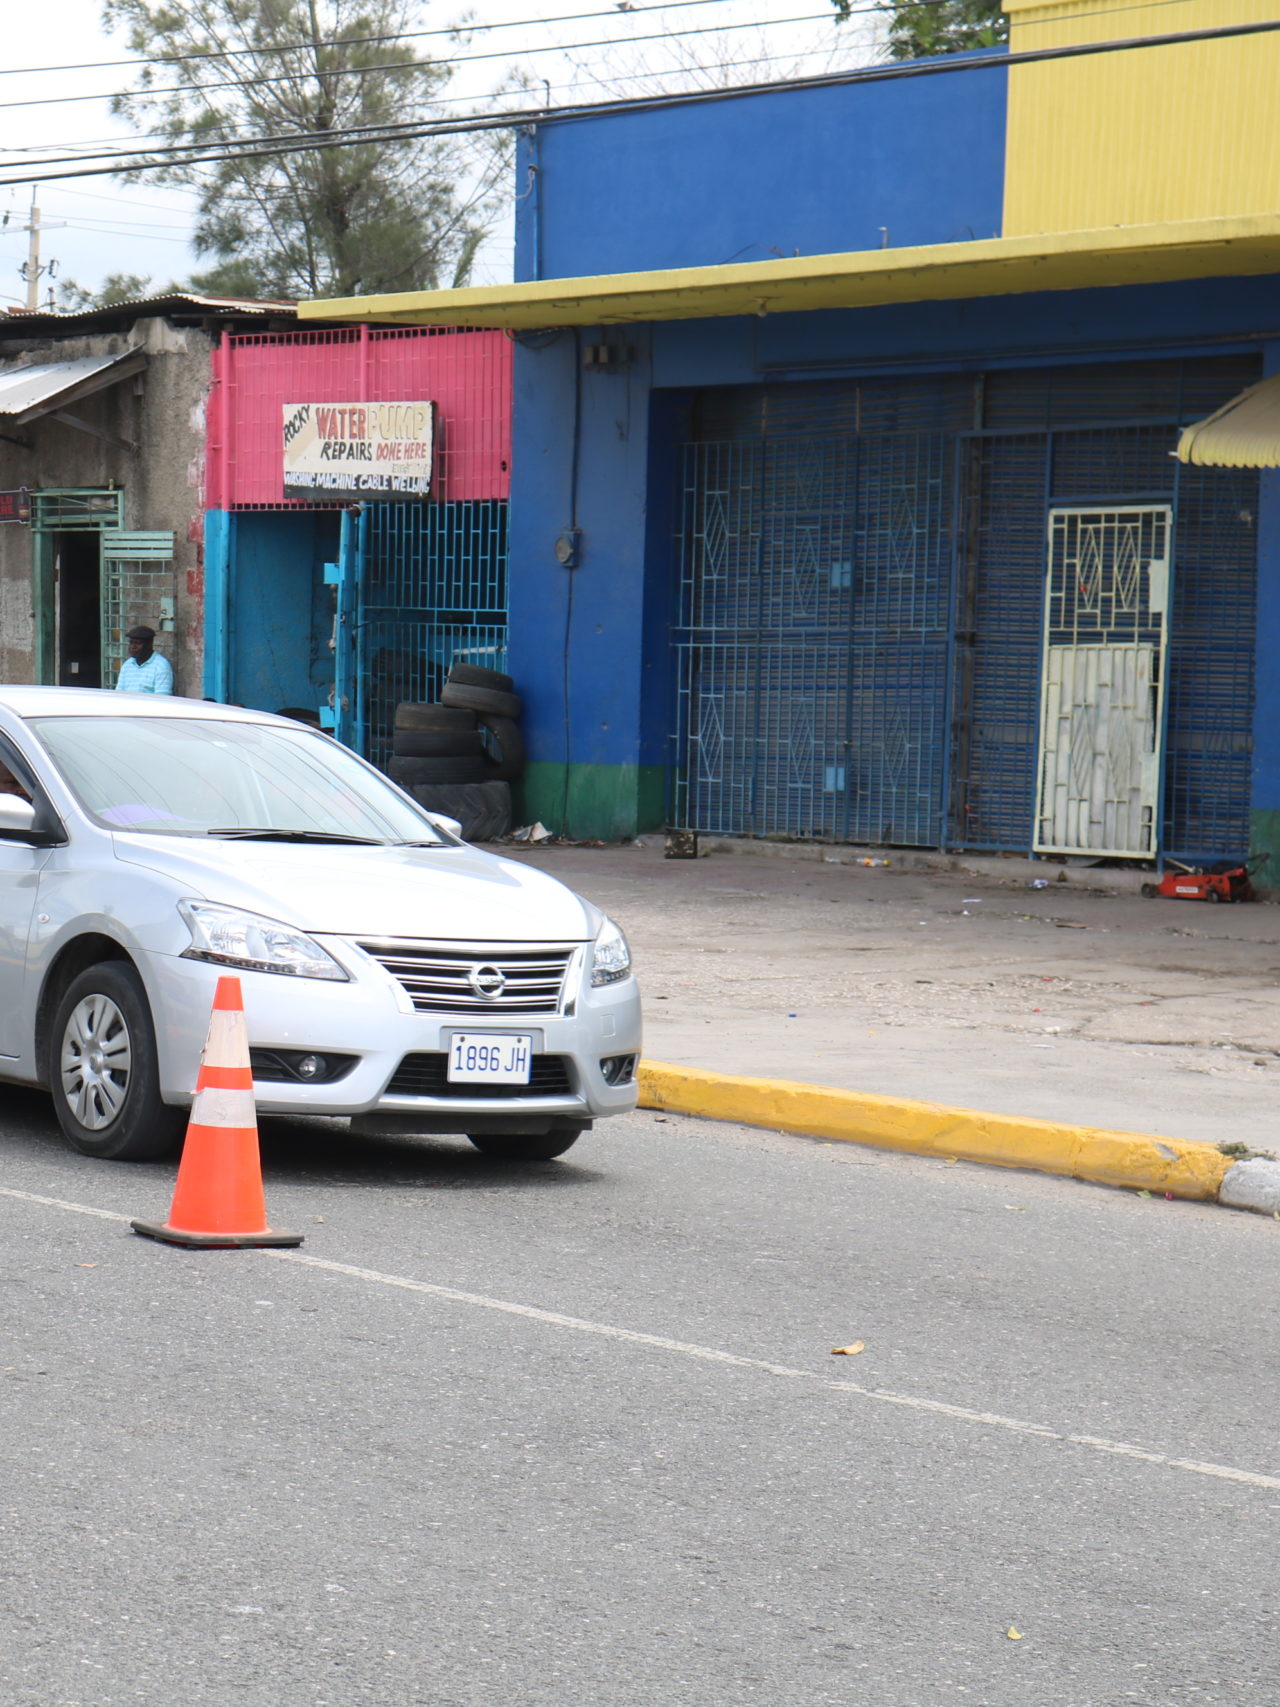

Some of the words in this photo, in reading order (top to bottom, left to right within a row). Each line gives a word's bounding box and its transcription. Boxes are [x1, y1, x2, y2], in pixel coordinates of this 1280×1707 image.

[284, 404, 311, 447] ROCKY
[315, 406, 367, 440] WATER
[320, 441, 373, 461] REPAIRS
[376, 442, 402, 461] DONE
[404, 442, 427, 460] HERE
[316, 472, 357, 490] MACHINE
[455, 1046, 500, 1072] 1896
[504, 1047, 527, 1073] JH
